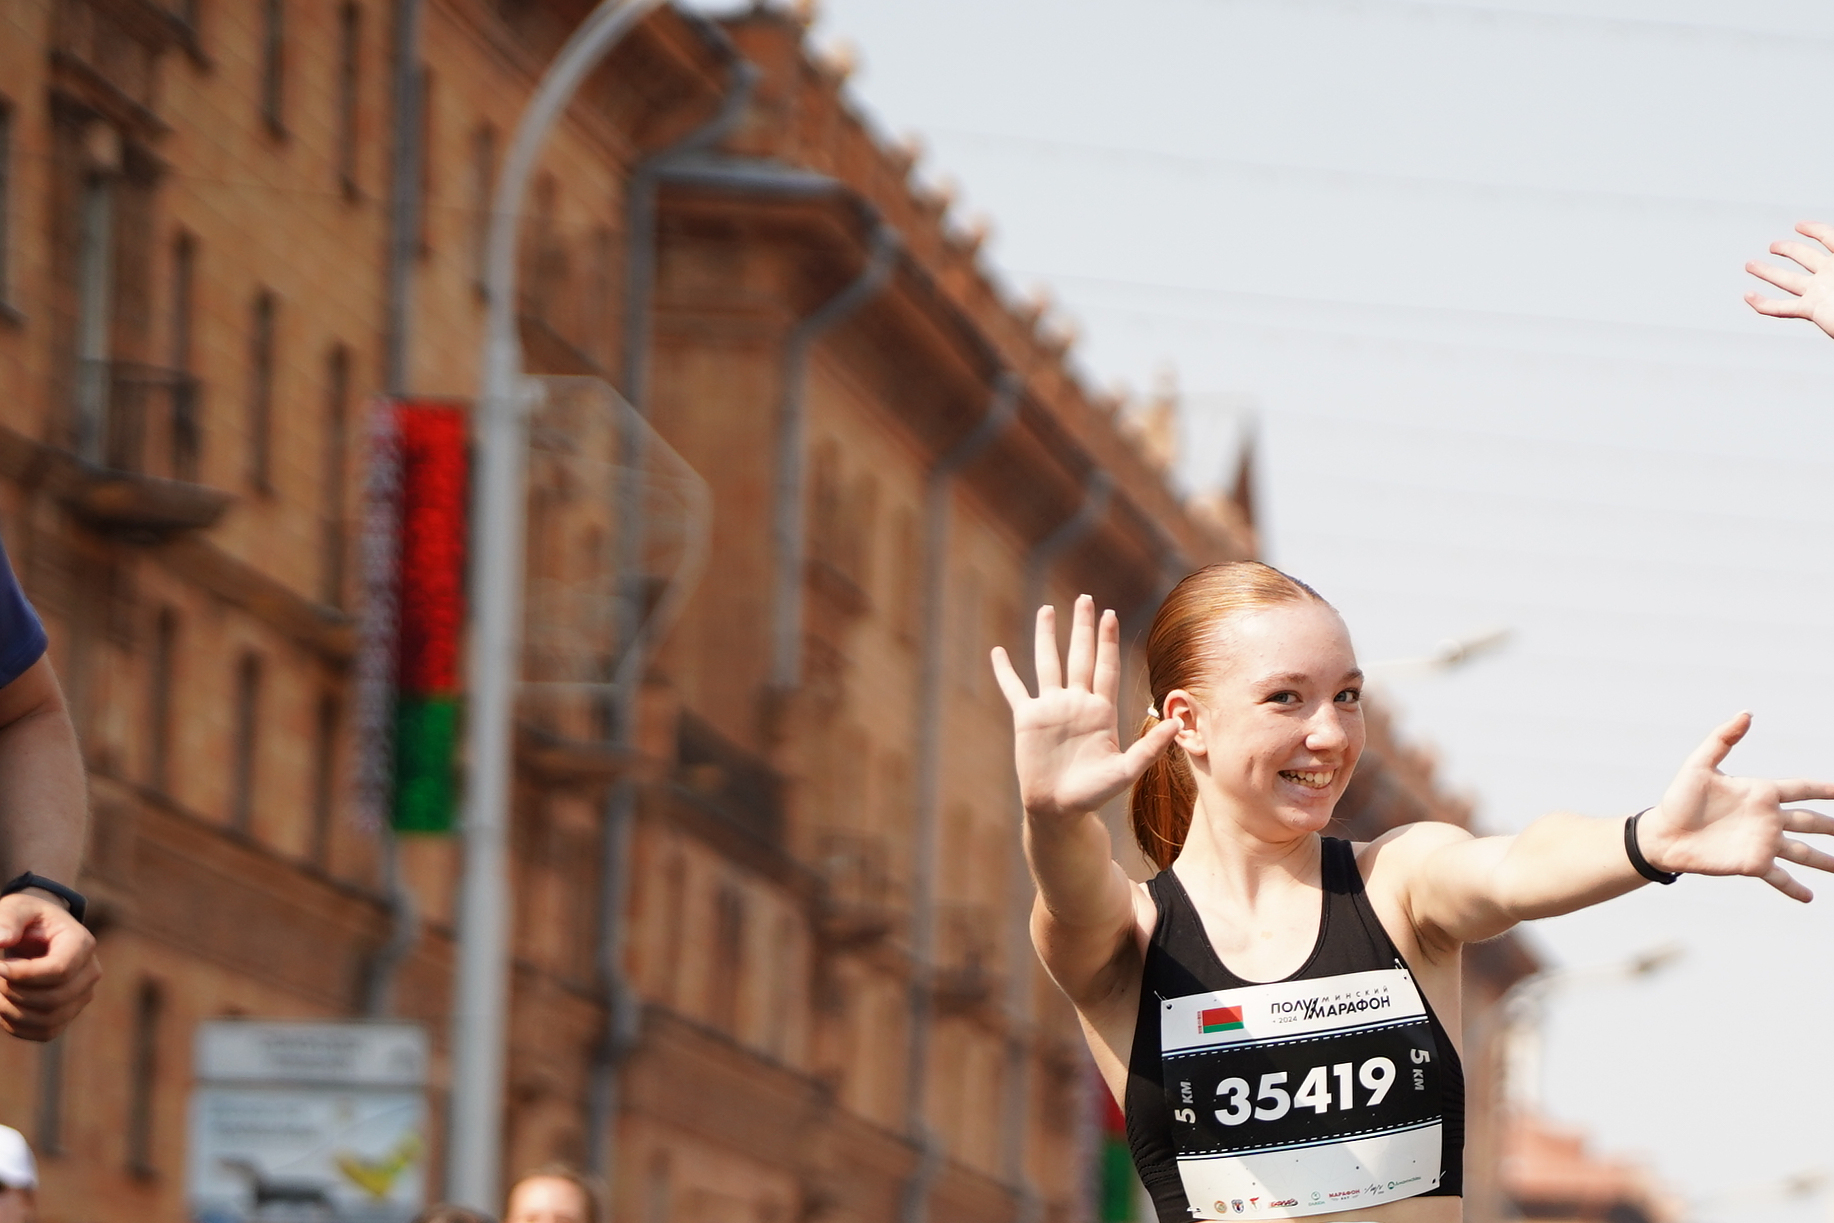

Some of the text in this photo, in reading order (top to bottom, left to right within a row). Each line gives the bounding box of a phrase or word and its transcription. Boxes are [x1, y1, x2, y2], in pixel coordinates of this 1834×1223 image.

[1322, 985, 1389, 1003] МИНСКИЙ
[1278, 1016, 1298, 1024] 2024
[1410, 1048, 1430, 1065] 5
[1214, 1056, 1397, 1126] 35419
[1174, 1107, 1196, 1124] 5
